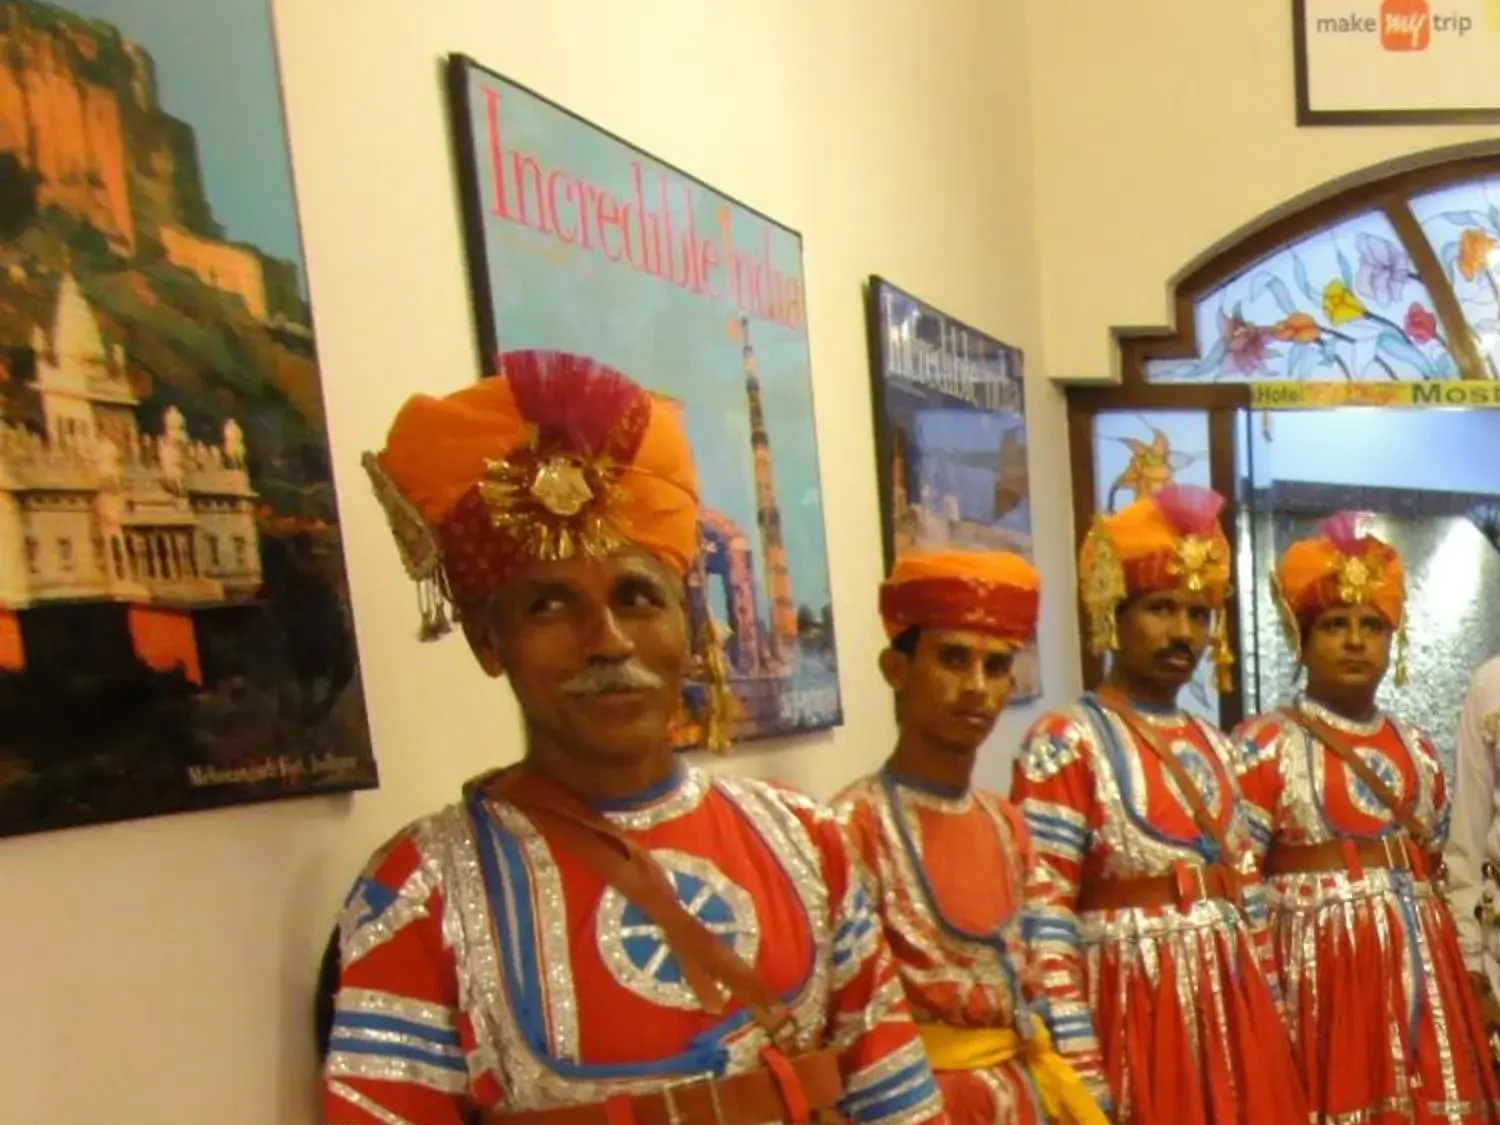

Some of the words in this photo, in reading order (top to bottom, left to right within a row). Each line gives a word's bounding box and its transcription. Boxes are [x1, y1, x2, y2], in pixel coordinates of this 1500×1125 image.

[1316, 13, 1377, 33] make
[1385, 13, 1427, 48] my
[1433, 12, 1473, 36] trip
[480, 84, 721, 295] Incredible
